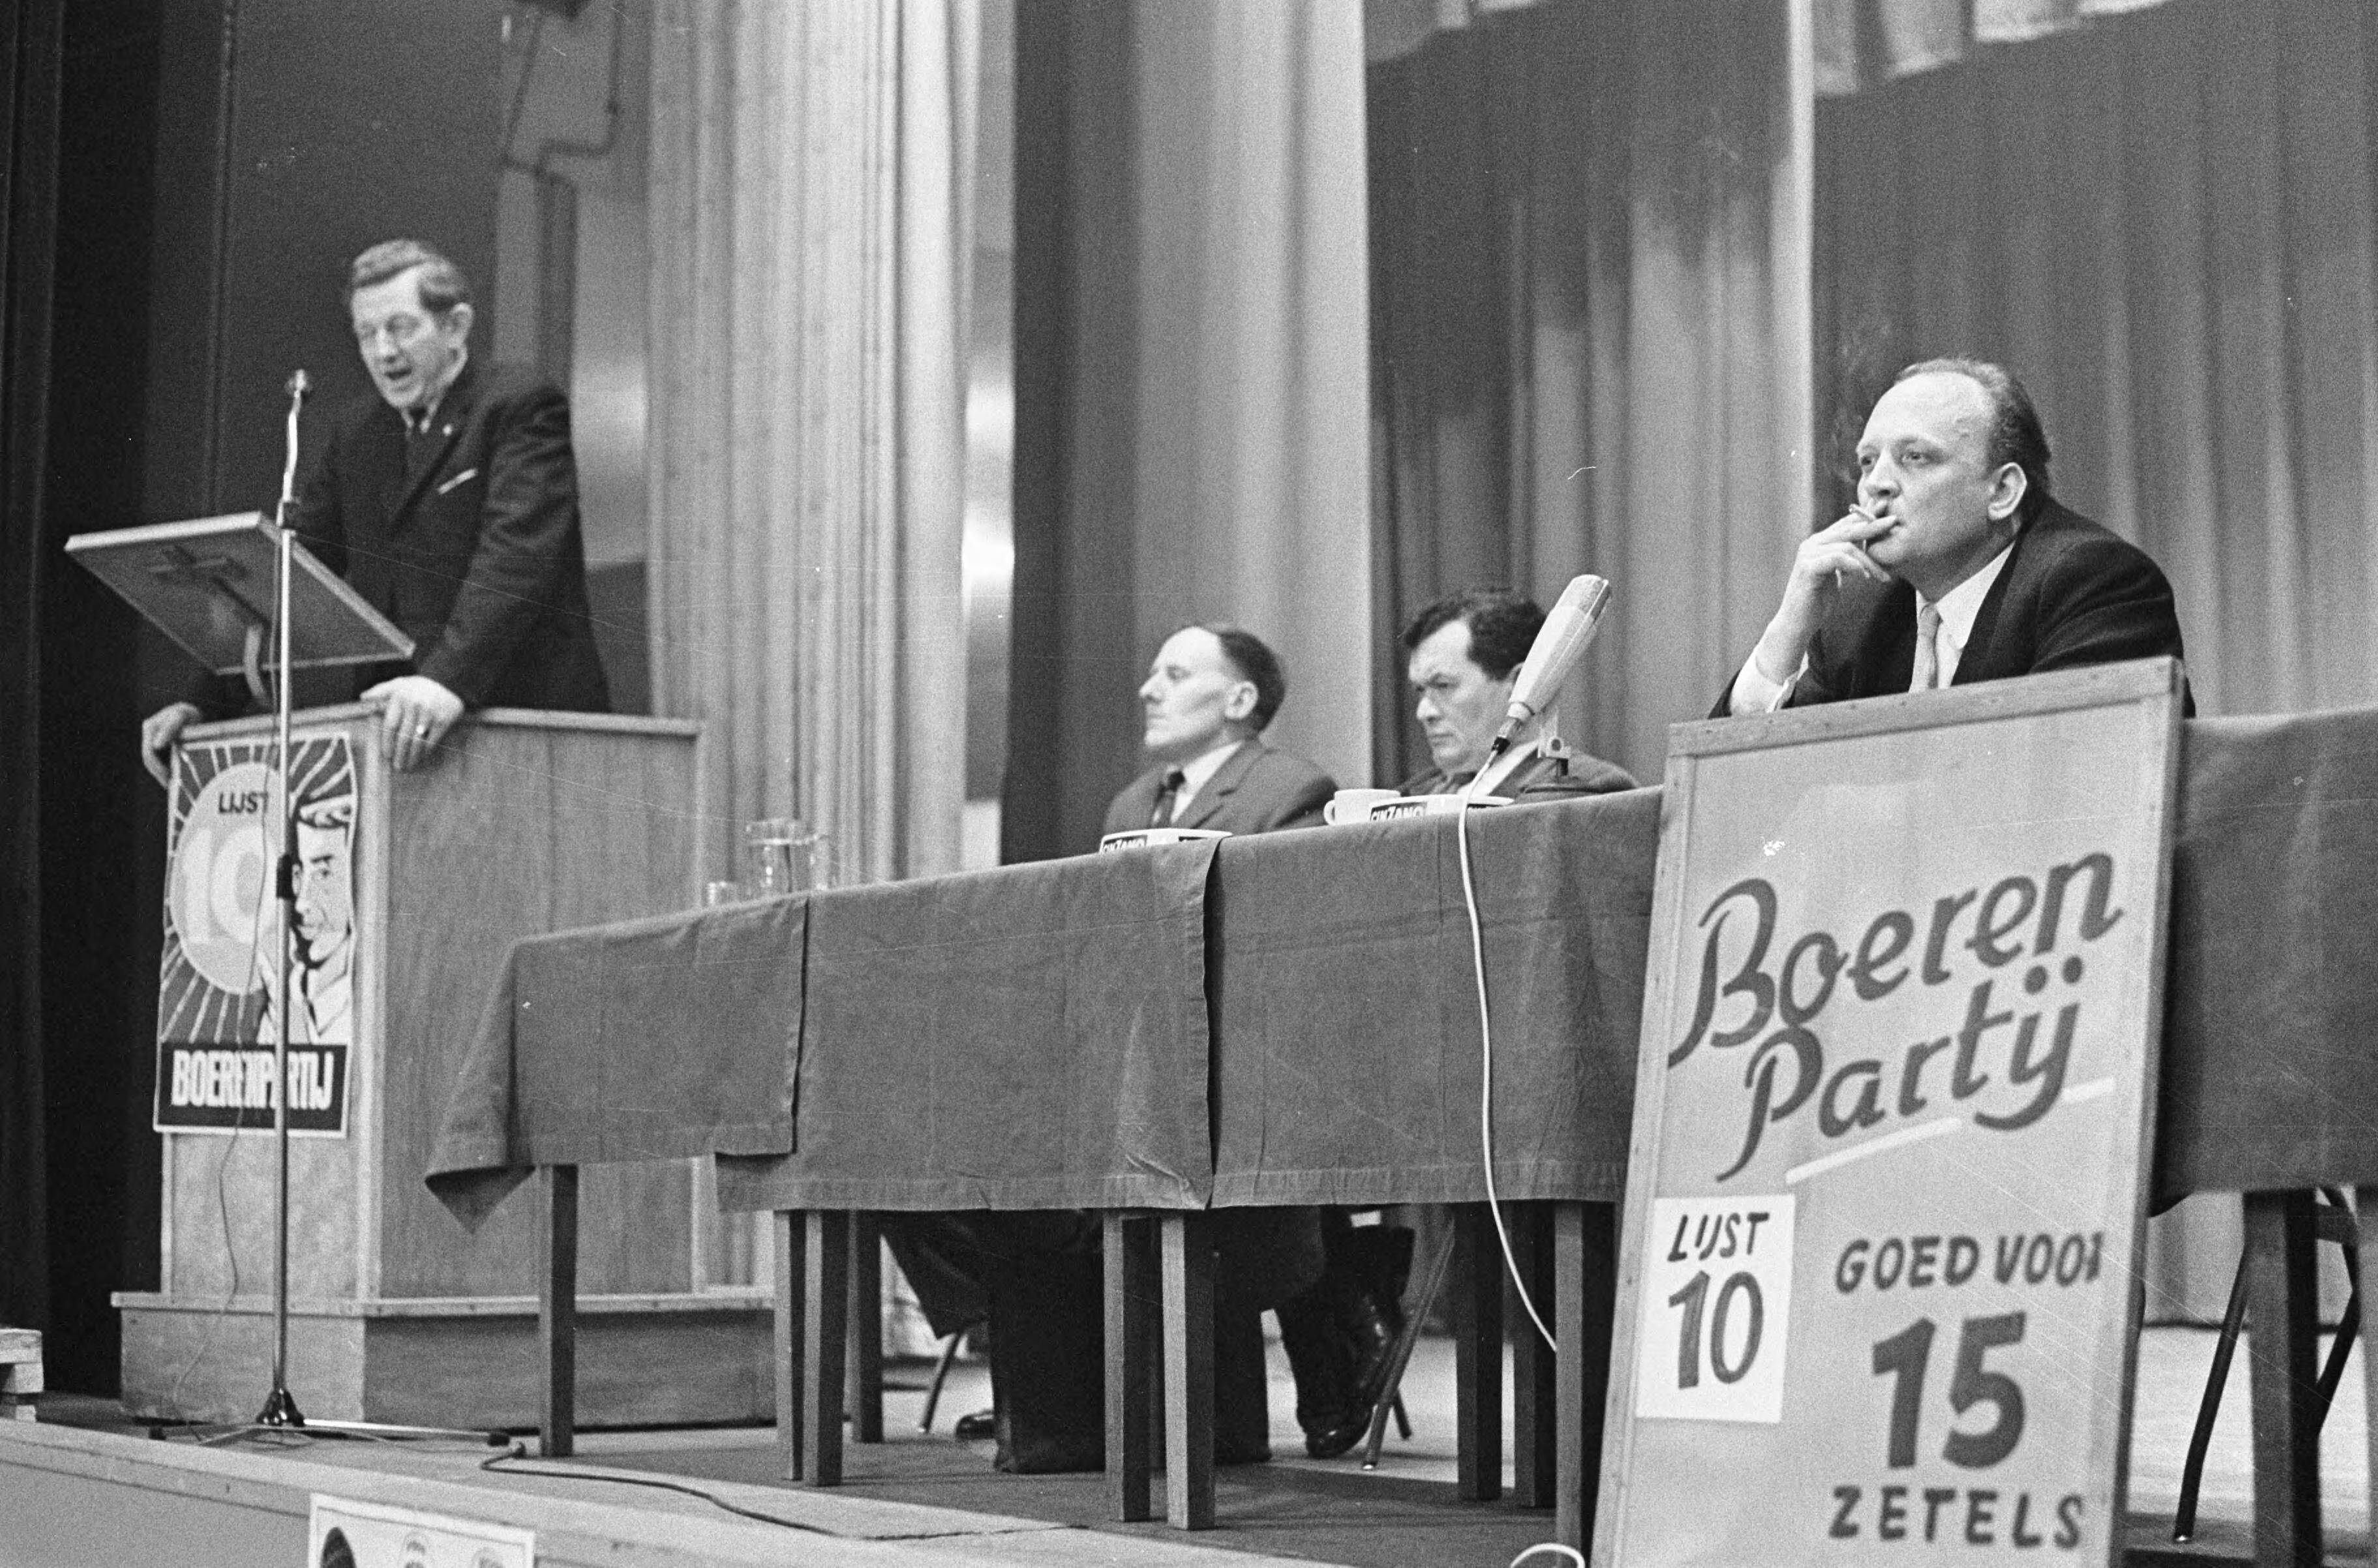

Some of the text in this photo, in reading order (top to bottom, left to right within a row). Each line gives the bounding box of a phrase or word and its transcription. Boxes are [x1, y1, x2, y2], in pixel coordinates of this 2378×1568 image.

[218, 791, 269, 814] LIJST
[184, 826, 279, 945] 10
[1667, 852, 2124, 1070] Boeren
[1714, 954, 2083, 1183] Partij
[1667, 1212, 1770, 1262] LIJST
[1836, 1236, 1980, 1294] GOED
[1668, 1270, 1764, 1390] 10
[1871, 1309, 2026, 1470] 15
[1828, 1485, 2085, 1549] ZETELS
